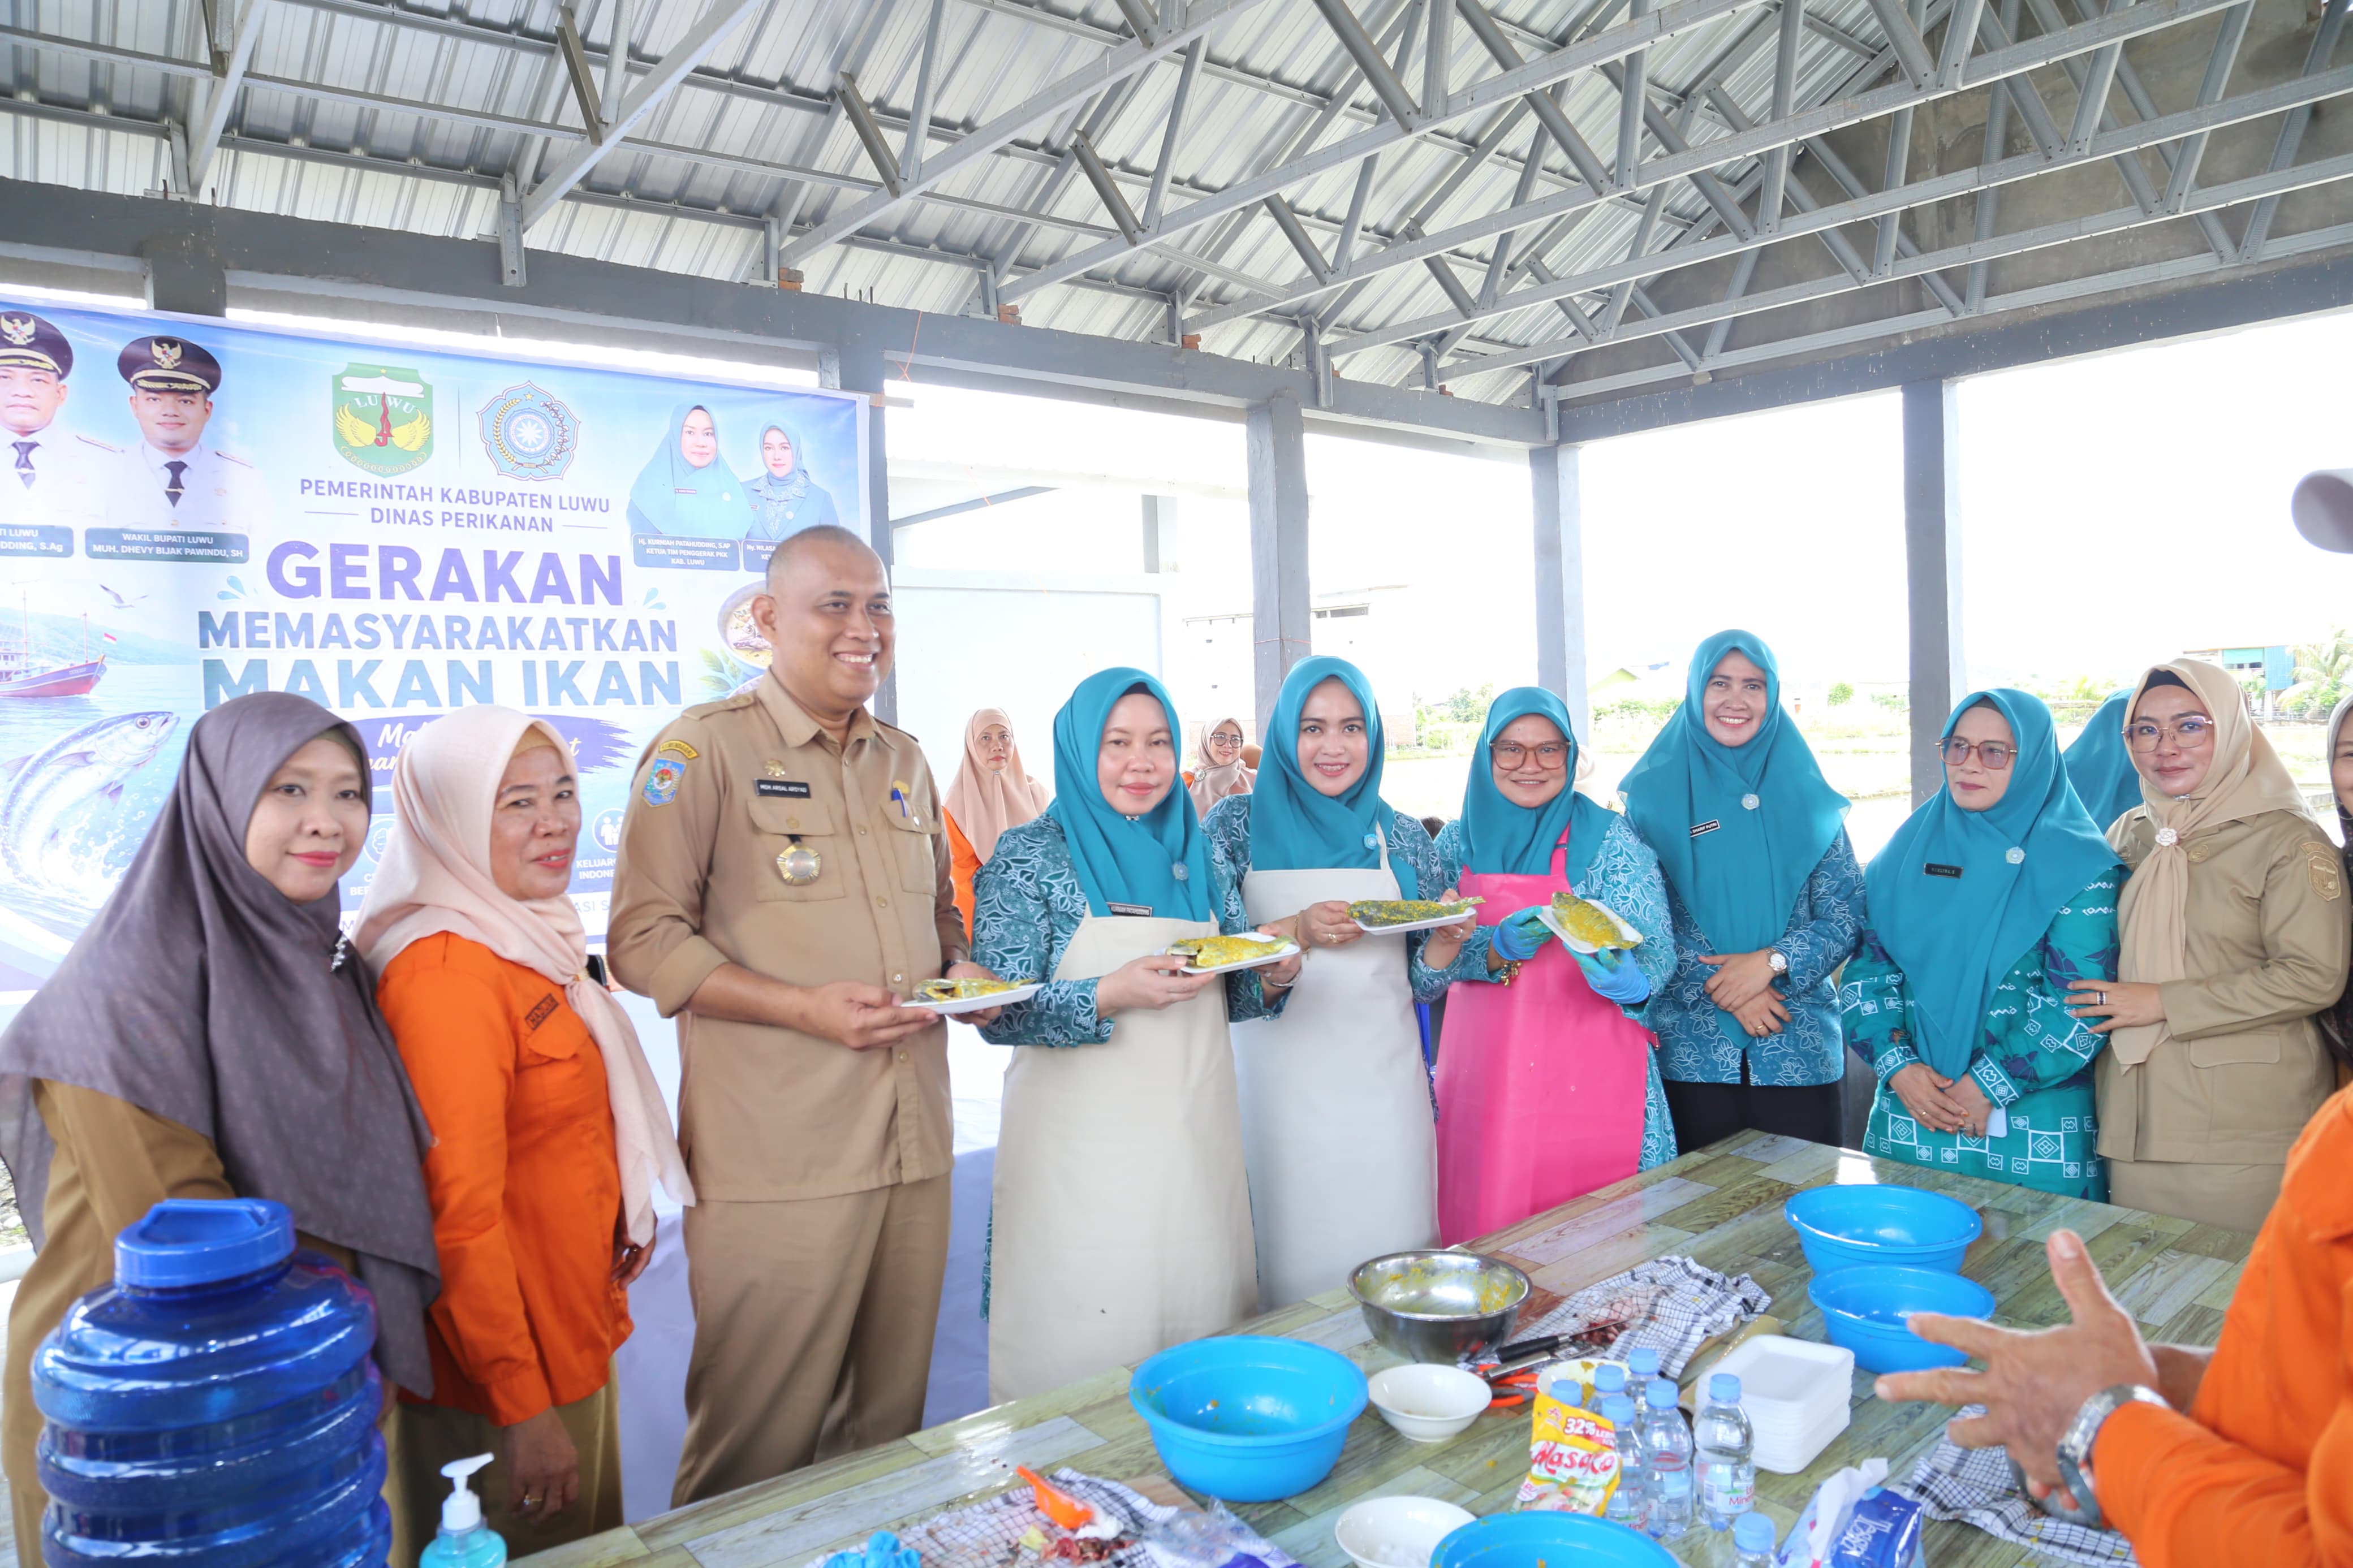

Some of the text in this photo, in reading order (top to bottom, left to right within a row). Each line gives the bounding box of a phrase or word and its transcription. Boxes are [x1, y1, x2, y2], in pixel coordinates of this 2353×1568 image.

[300, 479, 610, 513] PEMERINTAH KABUPATEN LUWU
[370, 508, 553, 533] DINAS PERIKANAN
[9, 529, 38, 537] LUWU
[122, 533, 152, 542] WAKIL
[154, 534, 185, 543] BUPATI
[40, 542, 63, 552] S.Ag
[93, 545, 118, 553] MUH.
[121, 546, 153, 554] DHEVY
[156, 547, 182, 555] BIJAK
[184, 548, 229, 558] PAWINDU,
[679, 550, 715, 558] PENGGERAK
[266, 540, 623, 606] GERAKAN
[198, 611, 678, 653] MEMASYARAKATKAN
[202, 659, 683, 710] MAKAN IKAN
[1564, 1416, 1597, 1435] 32%
